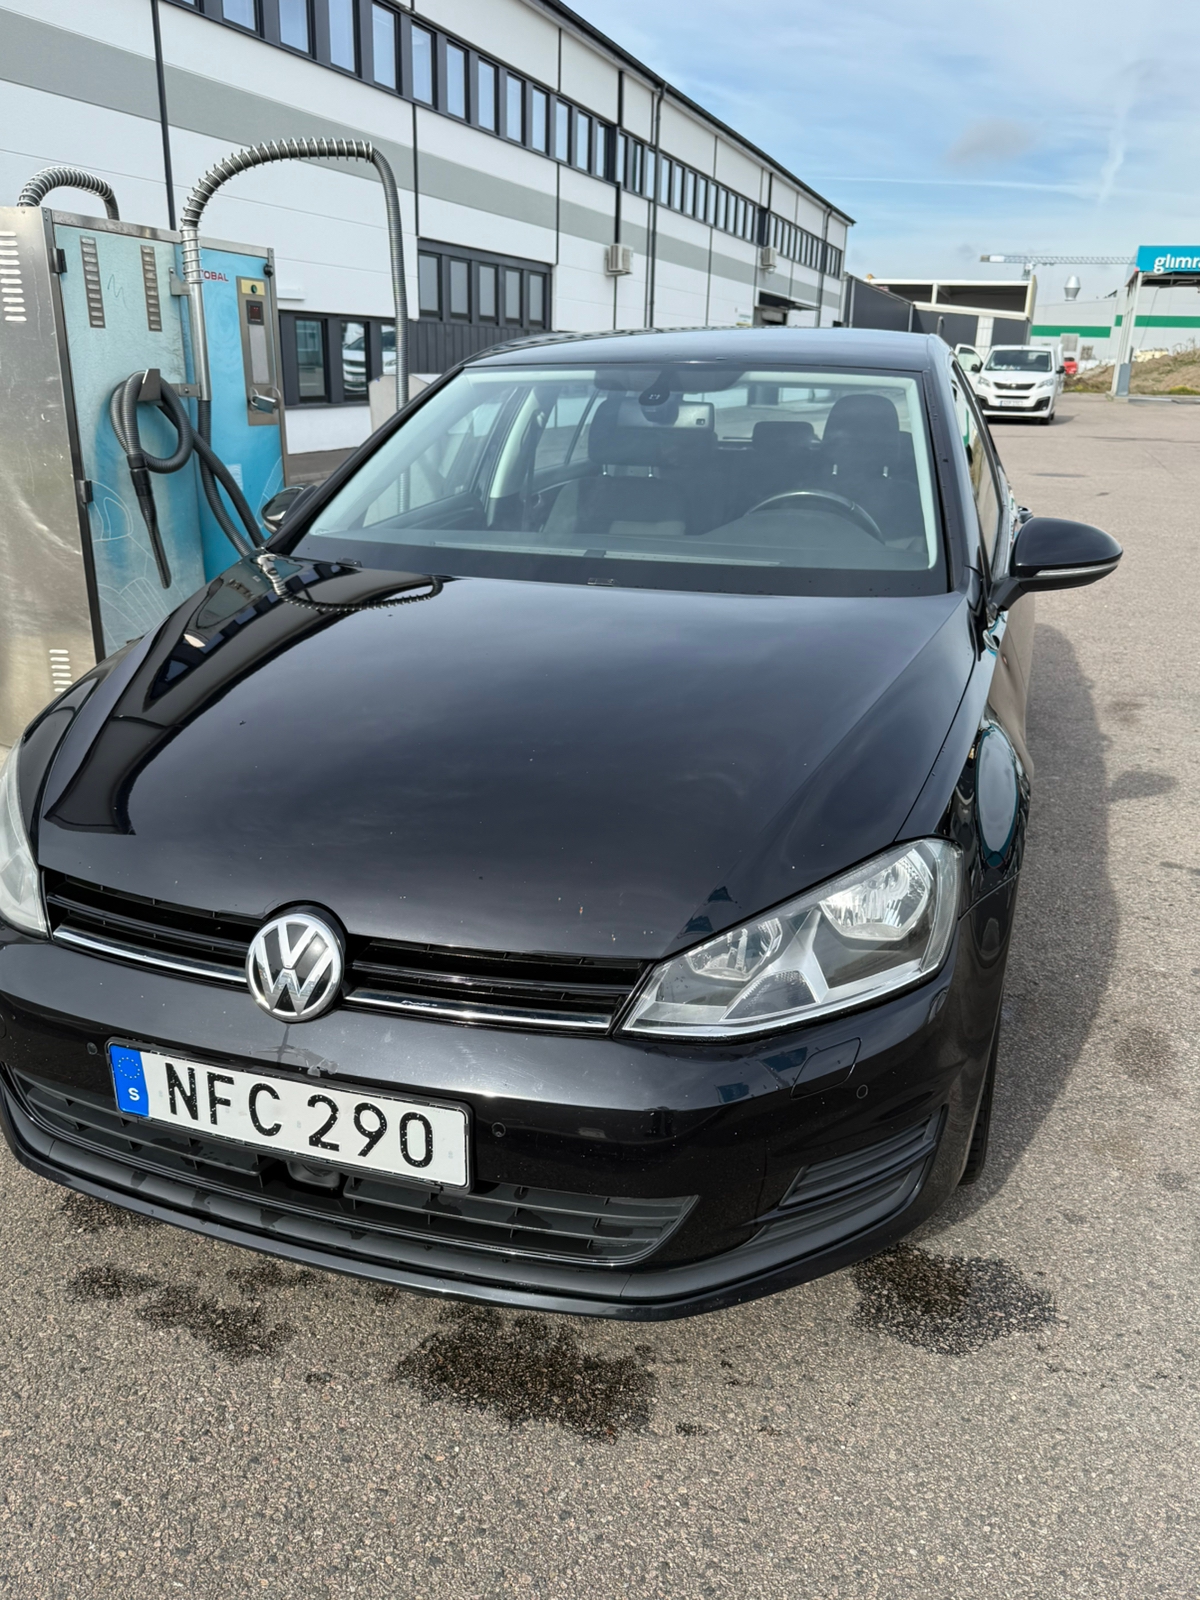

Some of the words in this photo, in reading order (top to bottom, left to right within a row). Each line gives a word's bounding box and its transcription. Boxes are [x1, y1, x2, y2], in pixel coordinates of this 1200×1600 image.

[1153, 253, 1200, 274] glimr
[246, 913, 344, 1022] VW
[128, 1087, 140, 1101] S
[165, 1062, 282, 1137] NFC
[307, 1094, 434, 1168] 290
